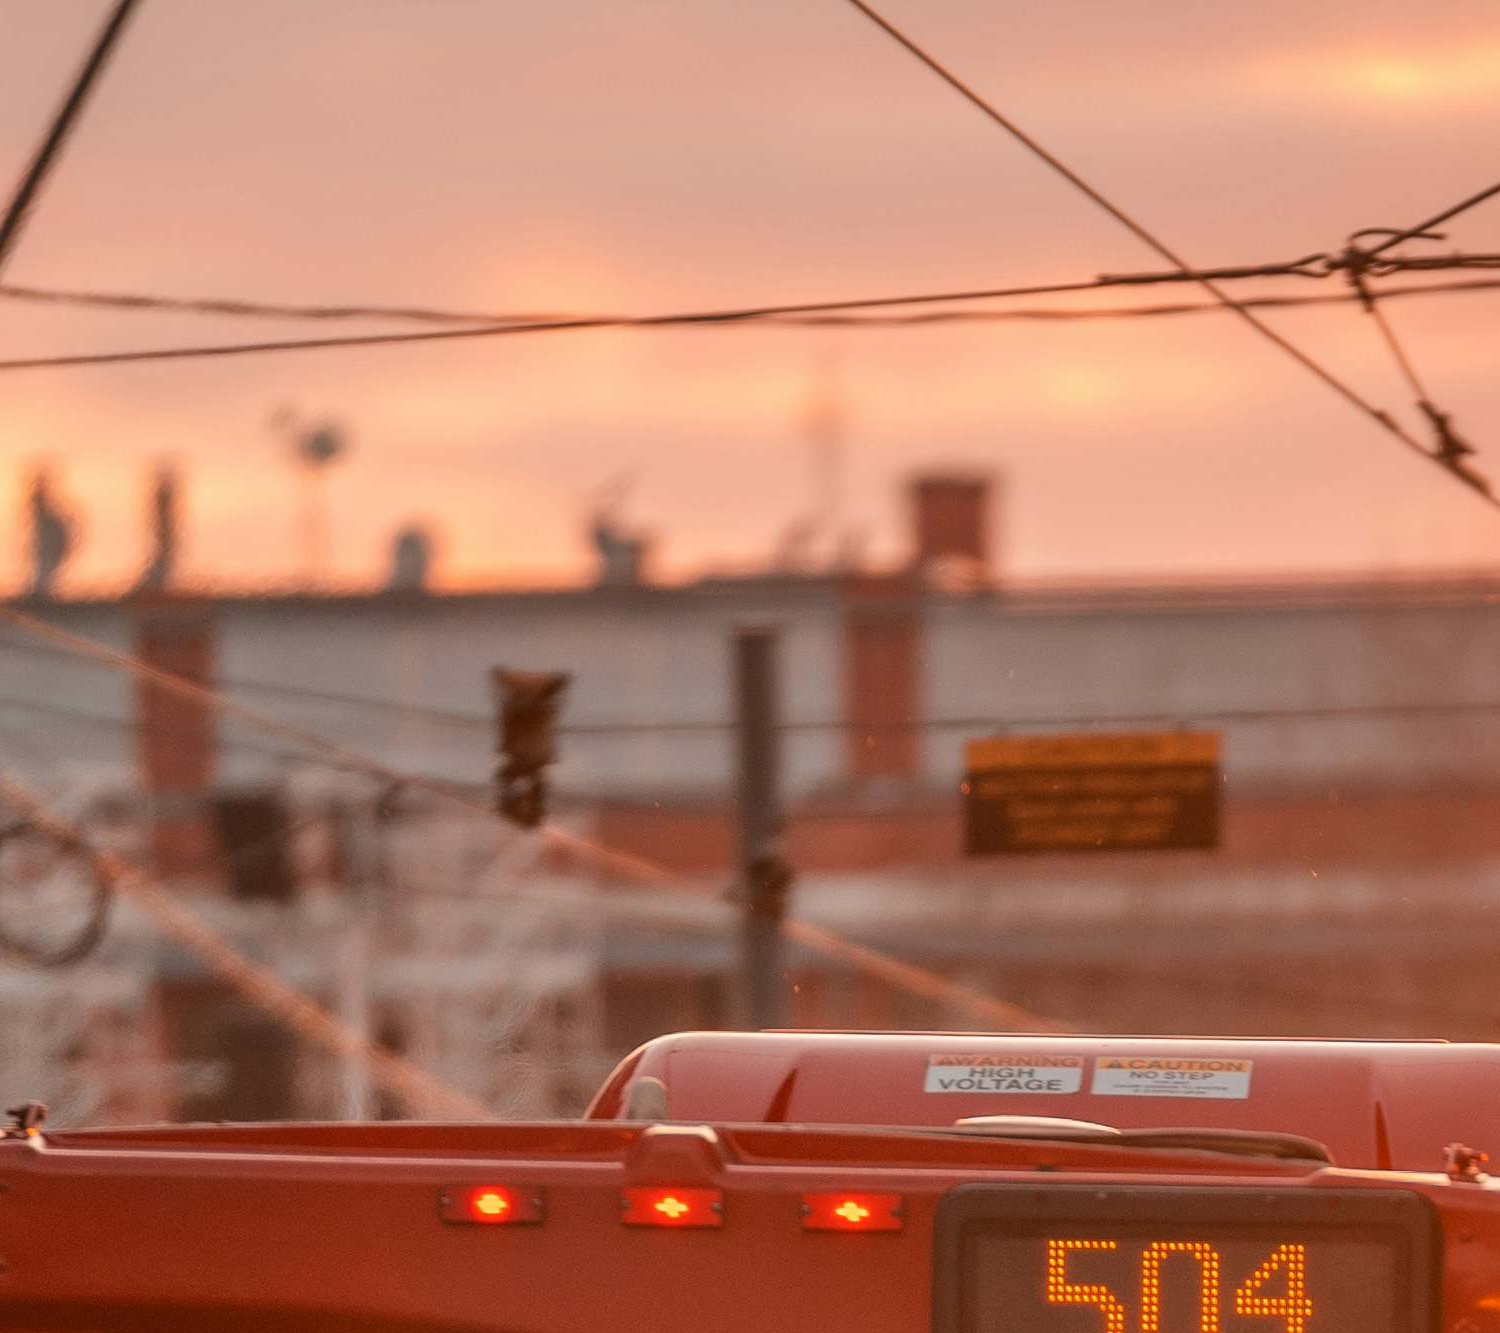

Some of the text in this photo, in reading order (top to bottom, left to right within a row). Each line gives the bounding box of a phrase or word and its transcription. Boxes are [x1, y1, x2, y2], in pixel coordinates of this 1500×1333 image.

[949, 1056, 1080, 1066] WARNING
[1128, 1059, 1243, 1071] CAUTION
[969, 1068, 1035, 1078] HIGH
[1129, 1071, 1215, 1080] NO STEP
[938, 1079, 1063, 1091] VOLTAGE
